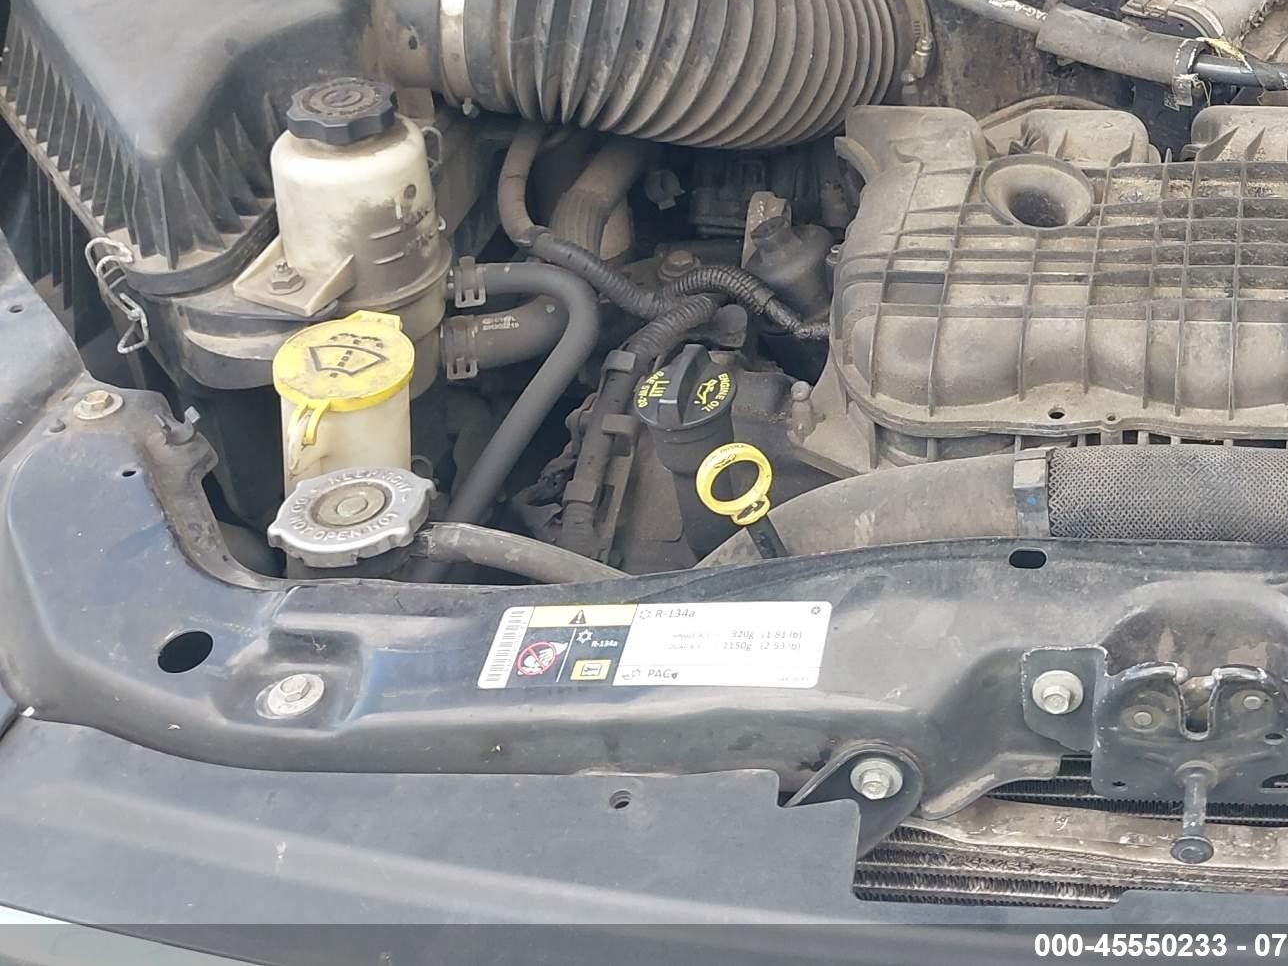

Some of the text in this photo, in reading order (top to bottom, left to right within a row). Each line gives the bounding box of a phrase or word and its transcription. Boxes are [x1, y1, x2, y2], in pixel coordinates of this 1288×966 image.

[700, 372, 731, 413] ENGINE OIL
[289, 497, 400, 542] DO NOT OPEN HOT
[655, 608, 696, 619] R-134a
